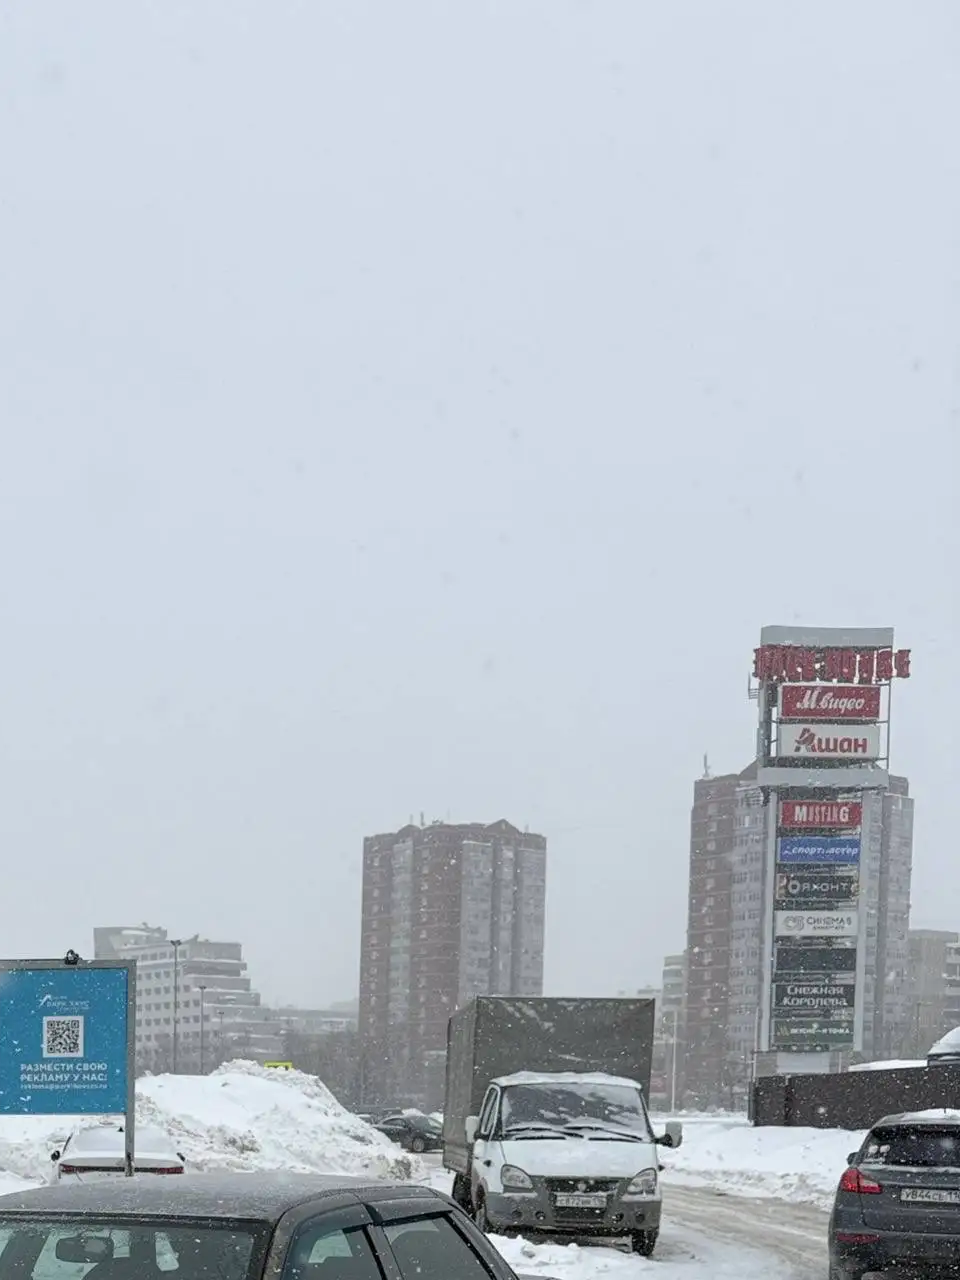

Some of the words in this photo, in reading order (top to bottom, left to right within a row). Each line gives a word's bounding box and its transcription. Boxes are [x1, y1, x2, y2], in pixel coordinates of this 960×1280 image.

[795, 728, 868, 753] Ашан
[20, 1063, 74, 1071] РАЗМЕСТИ
[75, 1063, 108, 1071] СВОЮ
[20, 1074, 72, 1082] РЕКЛАМУ
[72, 1074, 80, 1082] У
